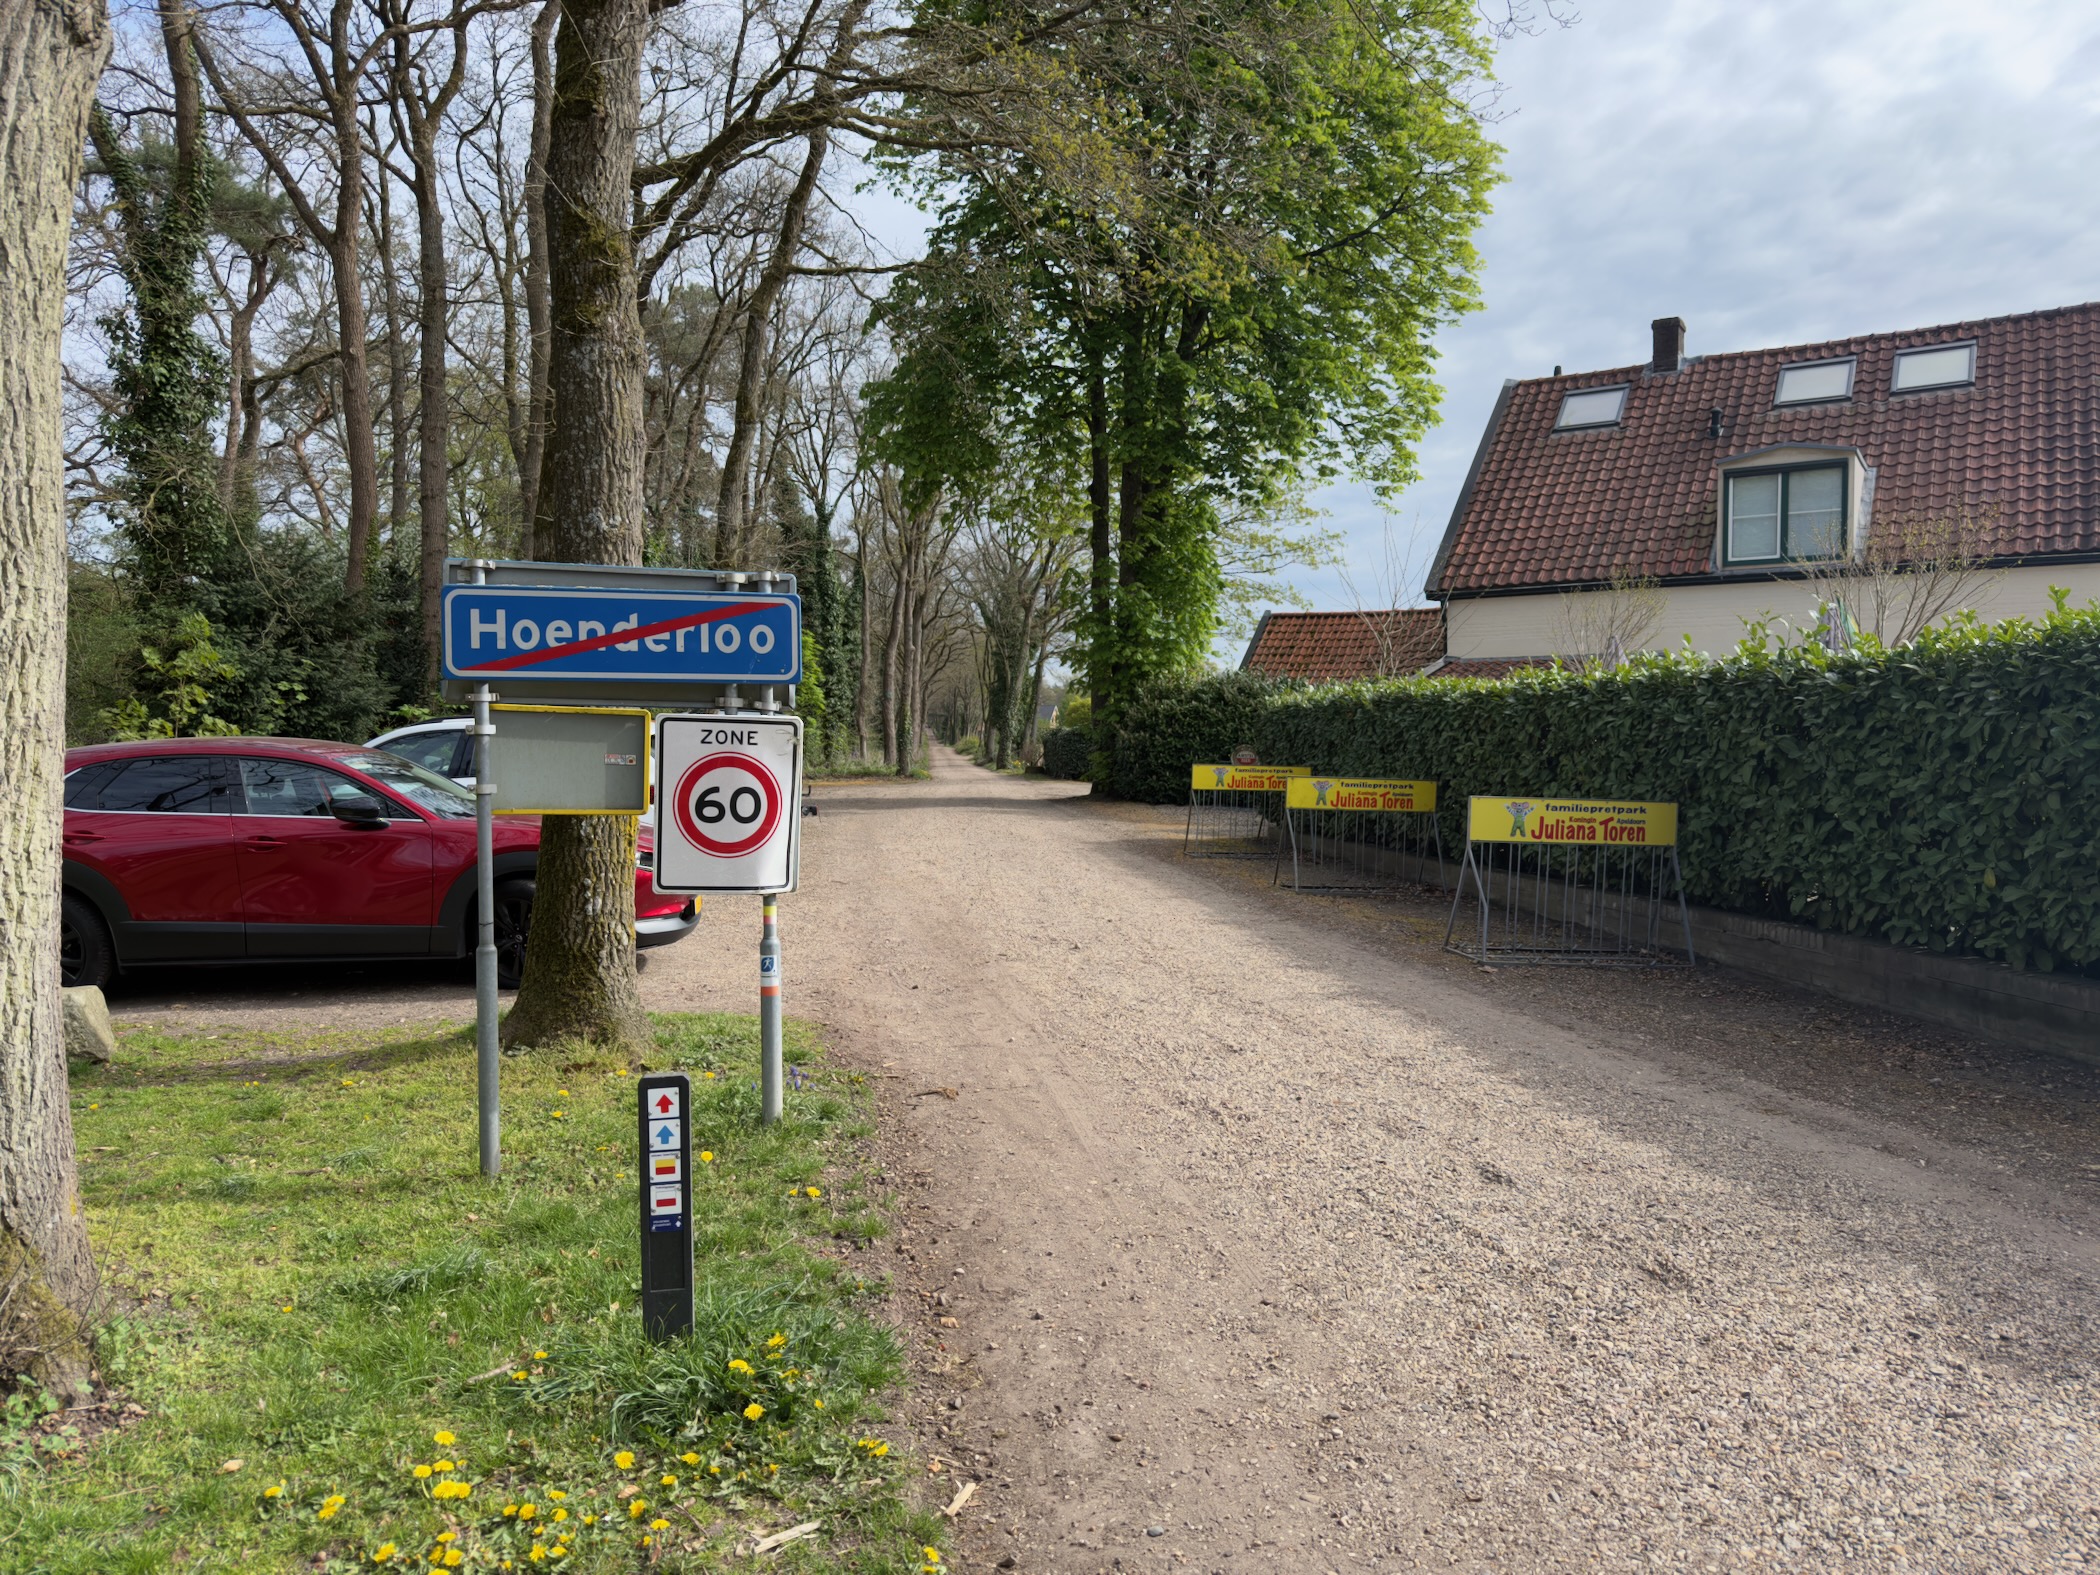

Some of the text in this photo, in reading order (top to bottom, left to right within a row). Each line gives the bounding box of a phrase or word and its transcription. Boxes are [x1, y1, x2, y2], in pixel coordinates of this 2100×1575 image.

[469, 608, 776, 655] Hoenderloo
[700, 729, 758, 746] ZONE
[1227, 775, 1287, 789] Juliana Tore
[1340, 781, 1414, 790] familiepretpark
[694, 786, 762, 824] 60
[1330, 790, 1414, 810] Juliana Toren
[1545, 803, 1647, 815] familiepretpark
[1569, 816, 1597, 824] Koningin
[1531, 816, 1646, 842] Juliana Toren
